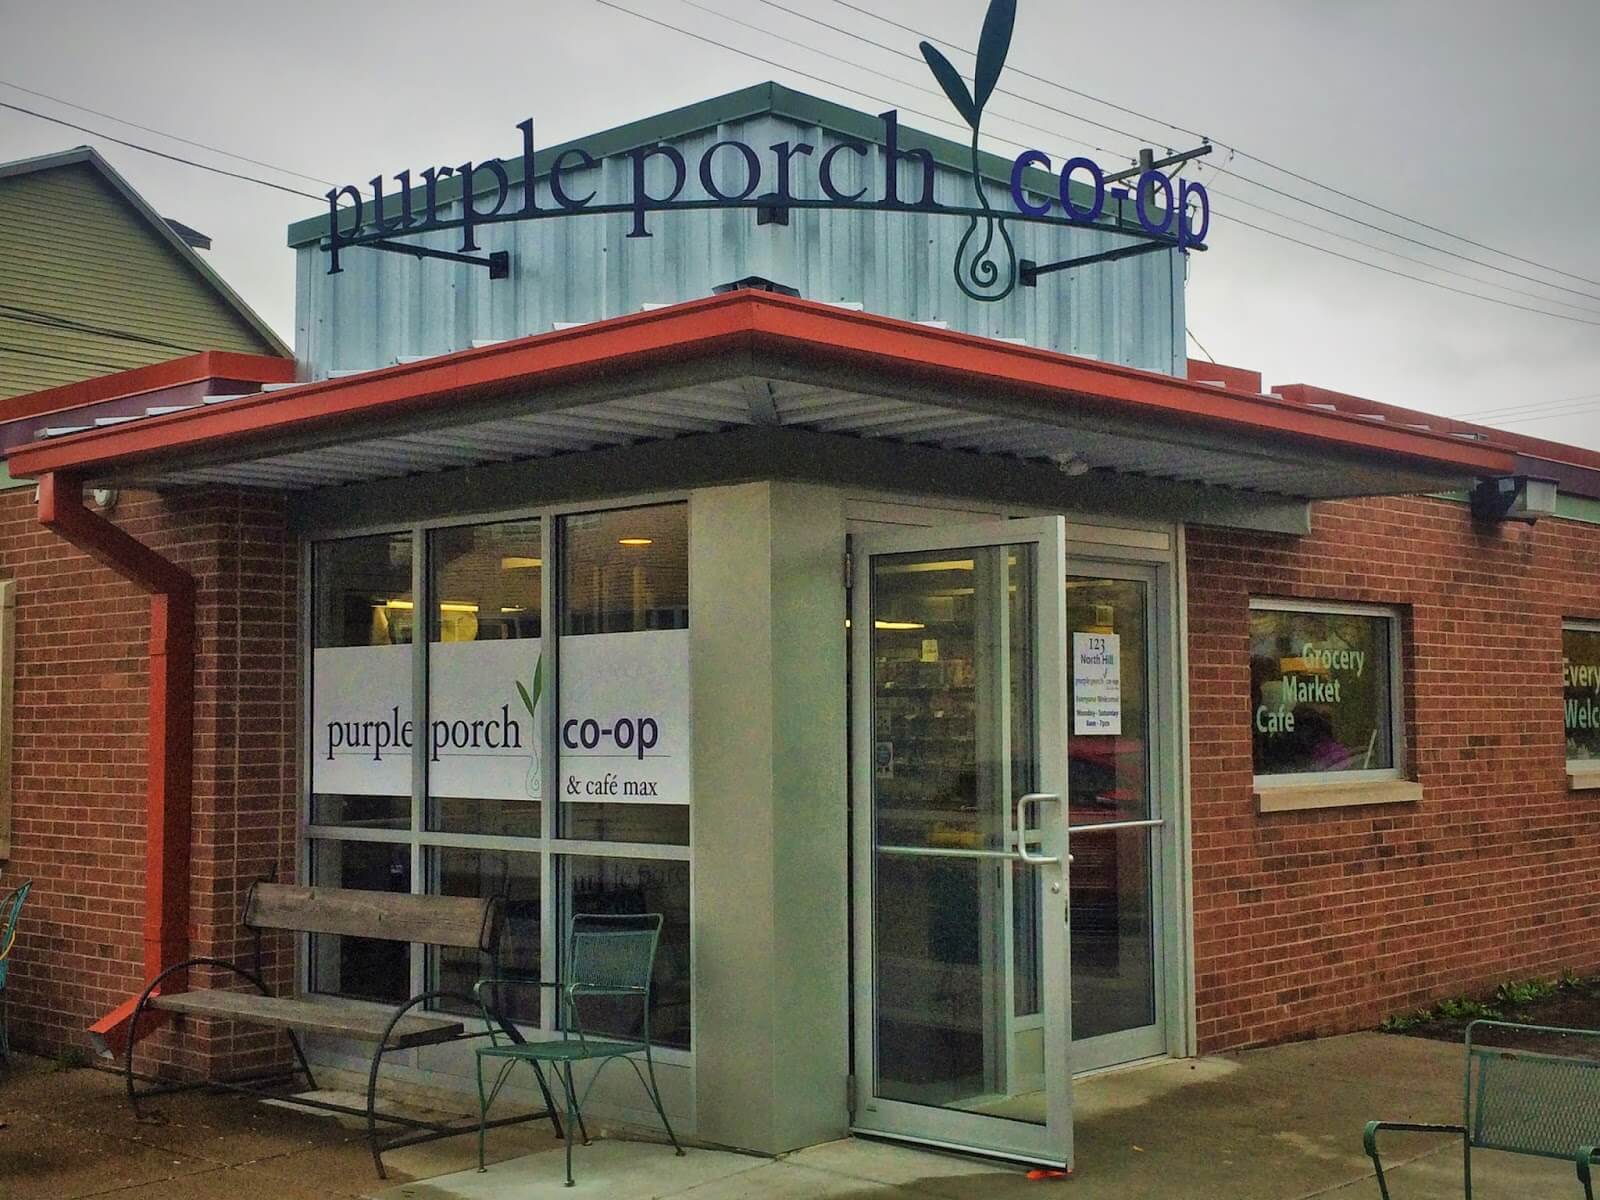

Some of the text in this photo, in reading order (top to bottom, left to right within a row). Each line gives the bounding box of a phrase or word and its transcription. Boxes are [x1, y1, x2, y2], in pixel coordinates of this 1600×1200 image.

[325, 108, 1210, 275] purple porch co-op
[1080, 653, 1113, 665] North Hill
[1089, 638, 1105, 656] 123
[1302, 642, 1365, 678] Grocery
[1281, 674, 1341, 703] Market
[327, 703, 659, 762] purple porch co-op
[566, 773, 658, 796] & café max
